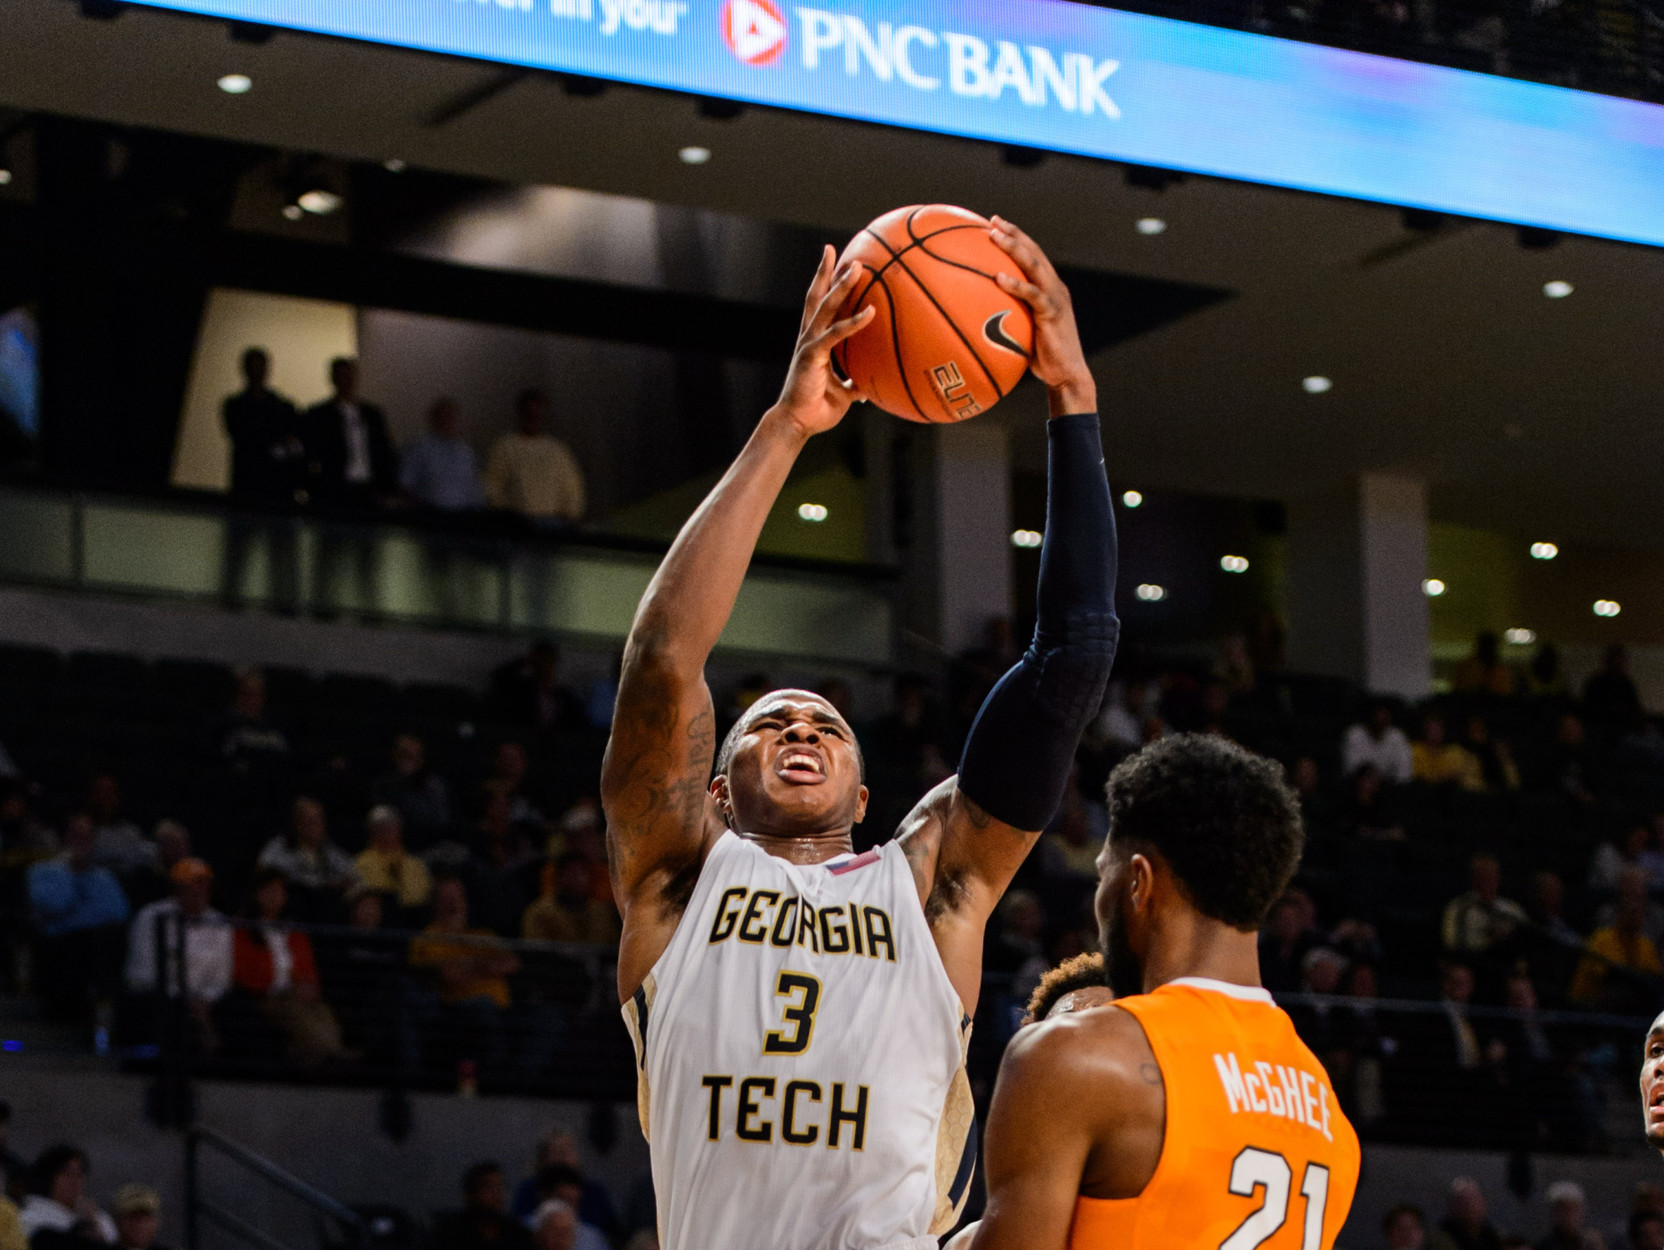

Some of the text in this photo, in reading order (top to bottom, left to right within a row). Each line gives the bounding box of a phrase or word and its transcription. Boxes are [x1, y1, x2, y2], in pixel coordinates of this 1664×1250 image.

[795, 5, 1121, 120] PNC BANK
[709, 886, 897, 964] GEORGIA
[762, 970, 823, 1057] 3
[701, 1075, 871, 1152] TECH
[1213, 1052, 1334, 1143] McGHEE
